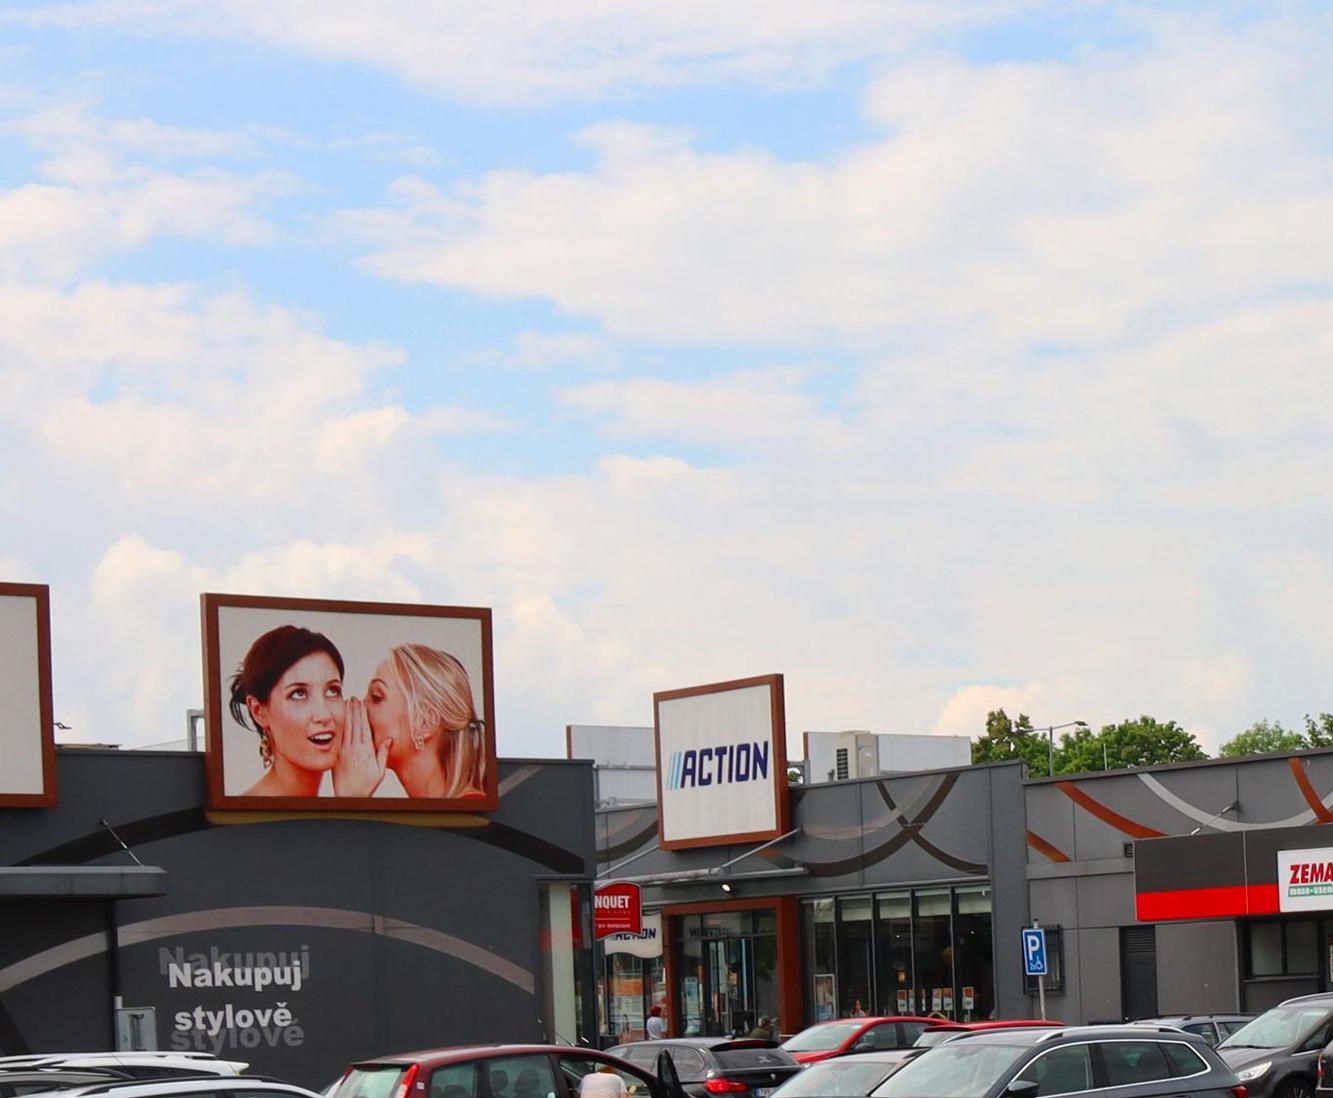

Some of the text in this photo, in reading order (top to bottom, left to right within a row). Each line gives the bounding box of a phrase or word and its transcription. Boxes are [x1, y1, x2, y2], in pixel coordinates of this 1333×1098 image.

[680, 741, 769, 789] ACTION
[1027, 935, 1041, 961] P
[168, 960, 302, 992] Nakupuj
[174, 1001, 293, 1036] stylově
